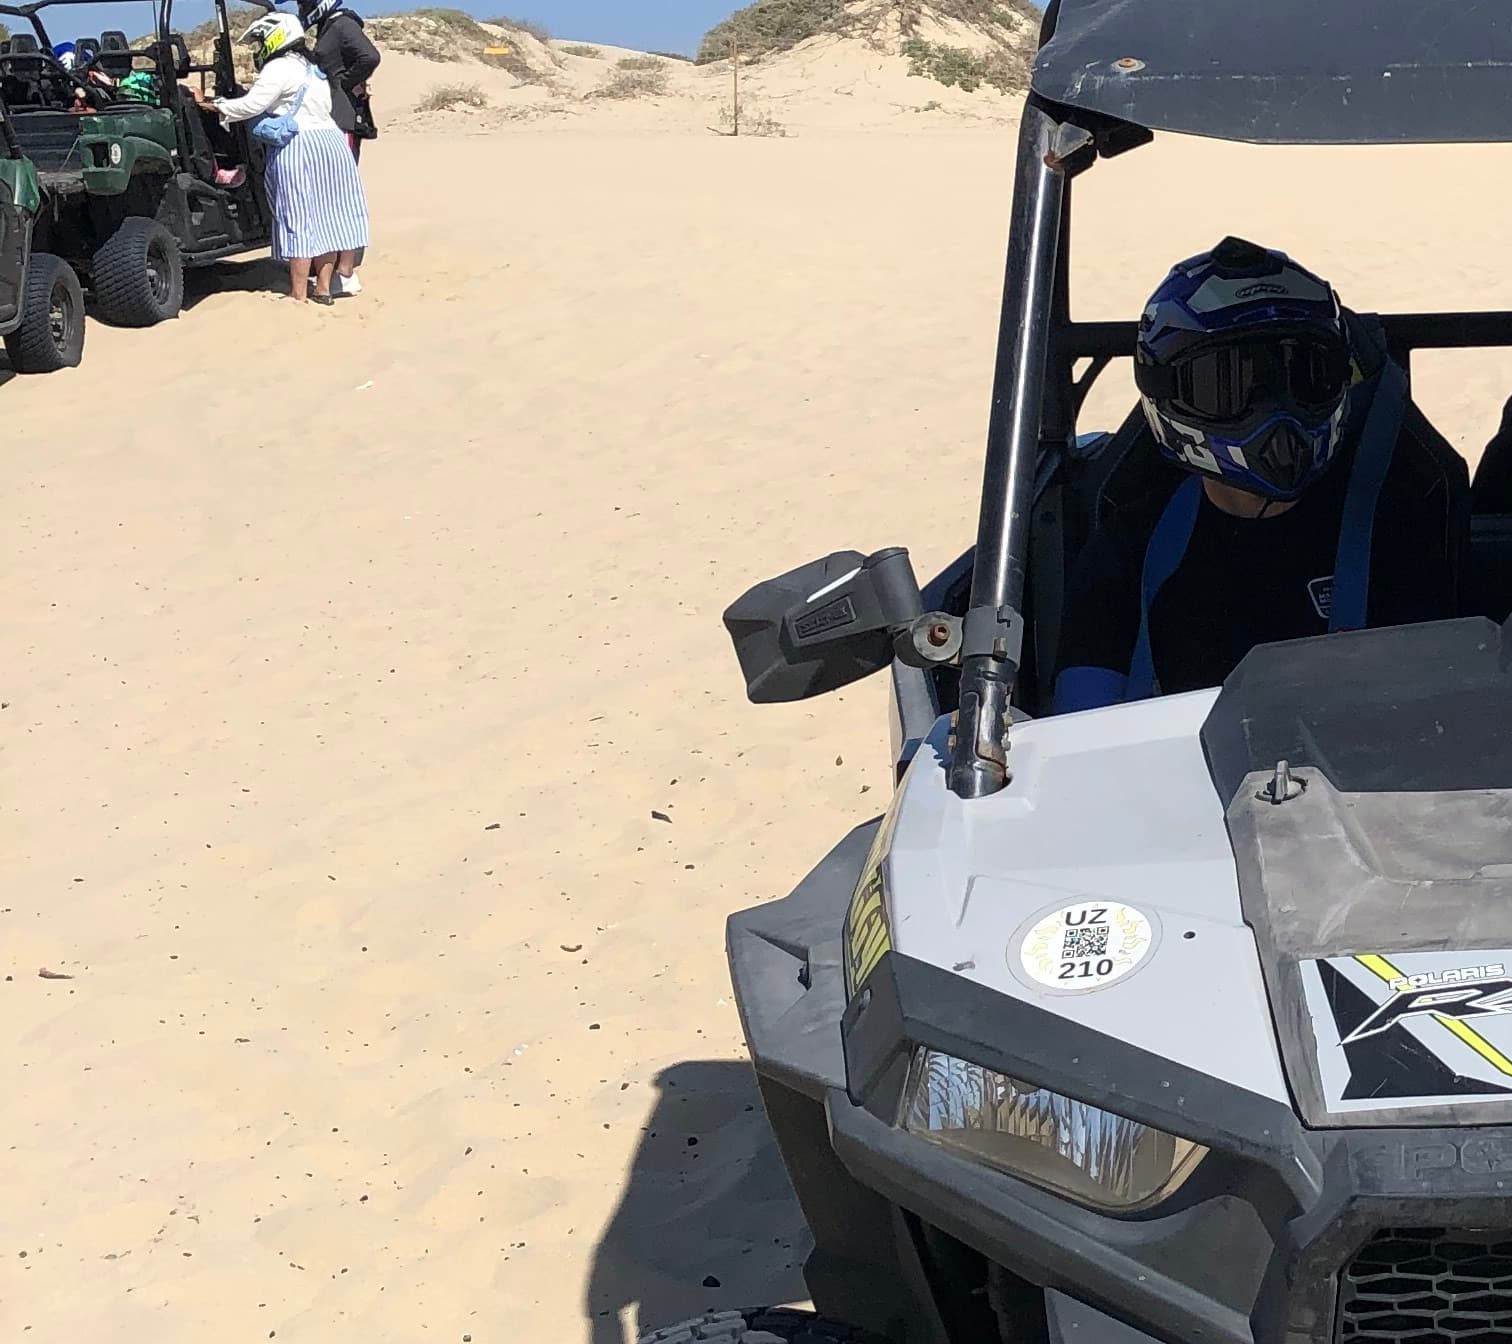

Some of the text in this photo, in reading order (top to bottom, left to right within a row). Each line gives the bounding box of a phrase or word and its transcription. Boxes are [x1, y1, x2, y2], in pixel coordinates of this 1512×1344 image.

[1065, 908, 1107, 926] UZ
[1057, 959, 1113, 979] 210
[1388, 963, 1505, 990] POLARIS
